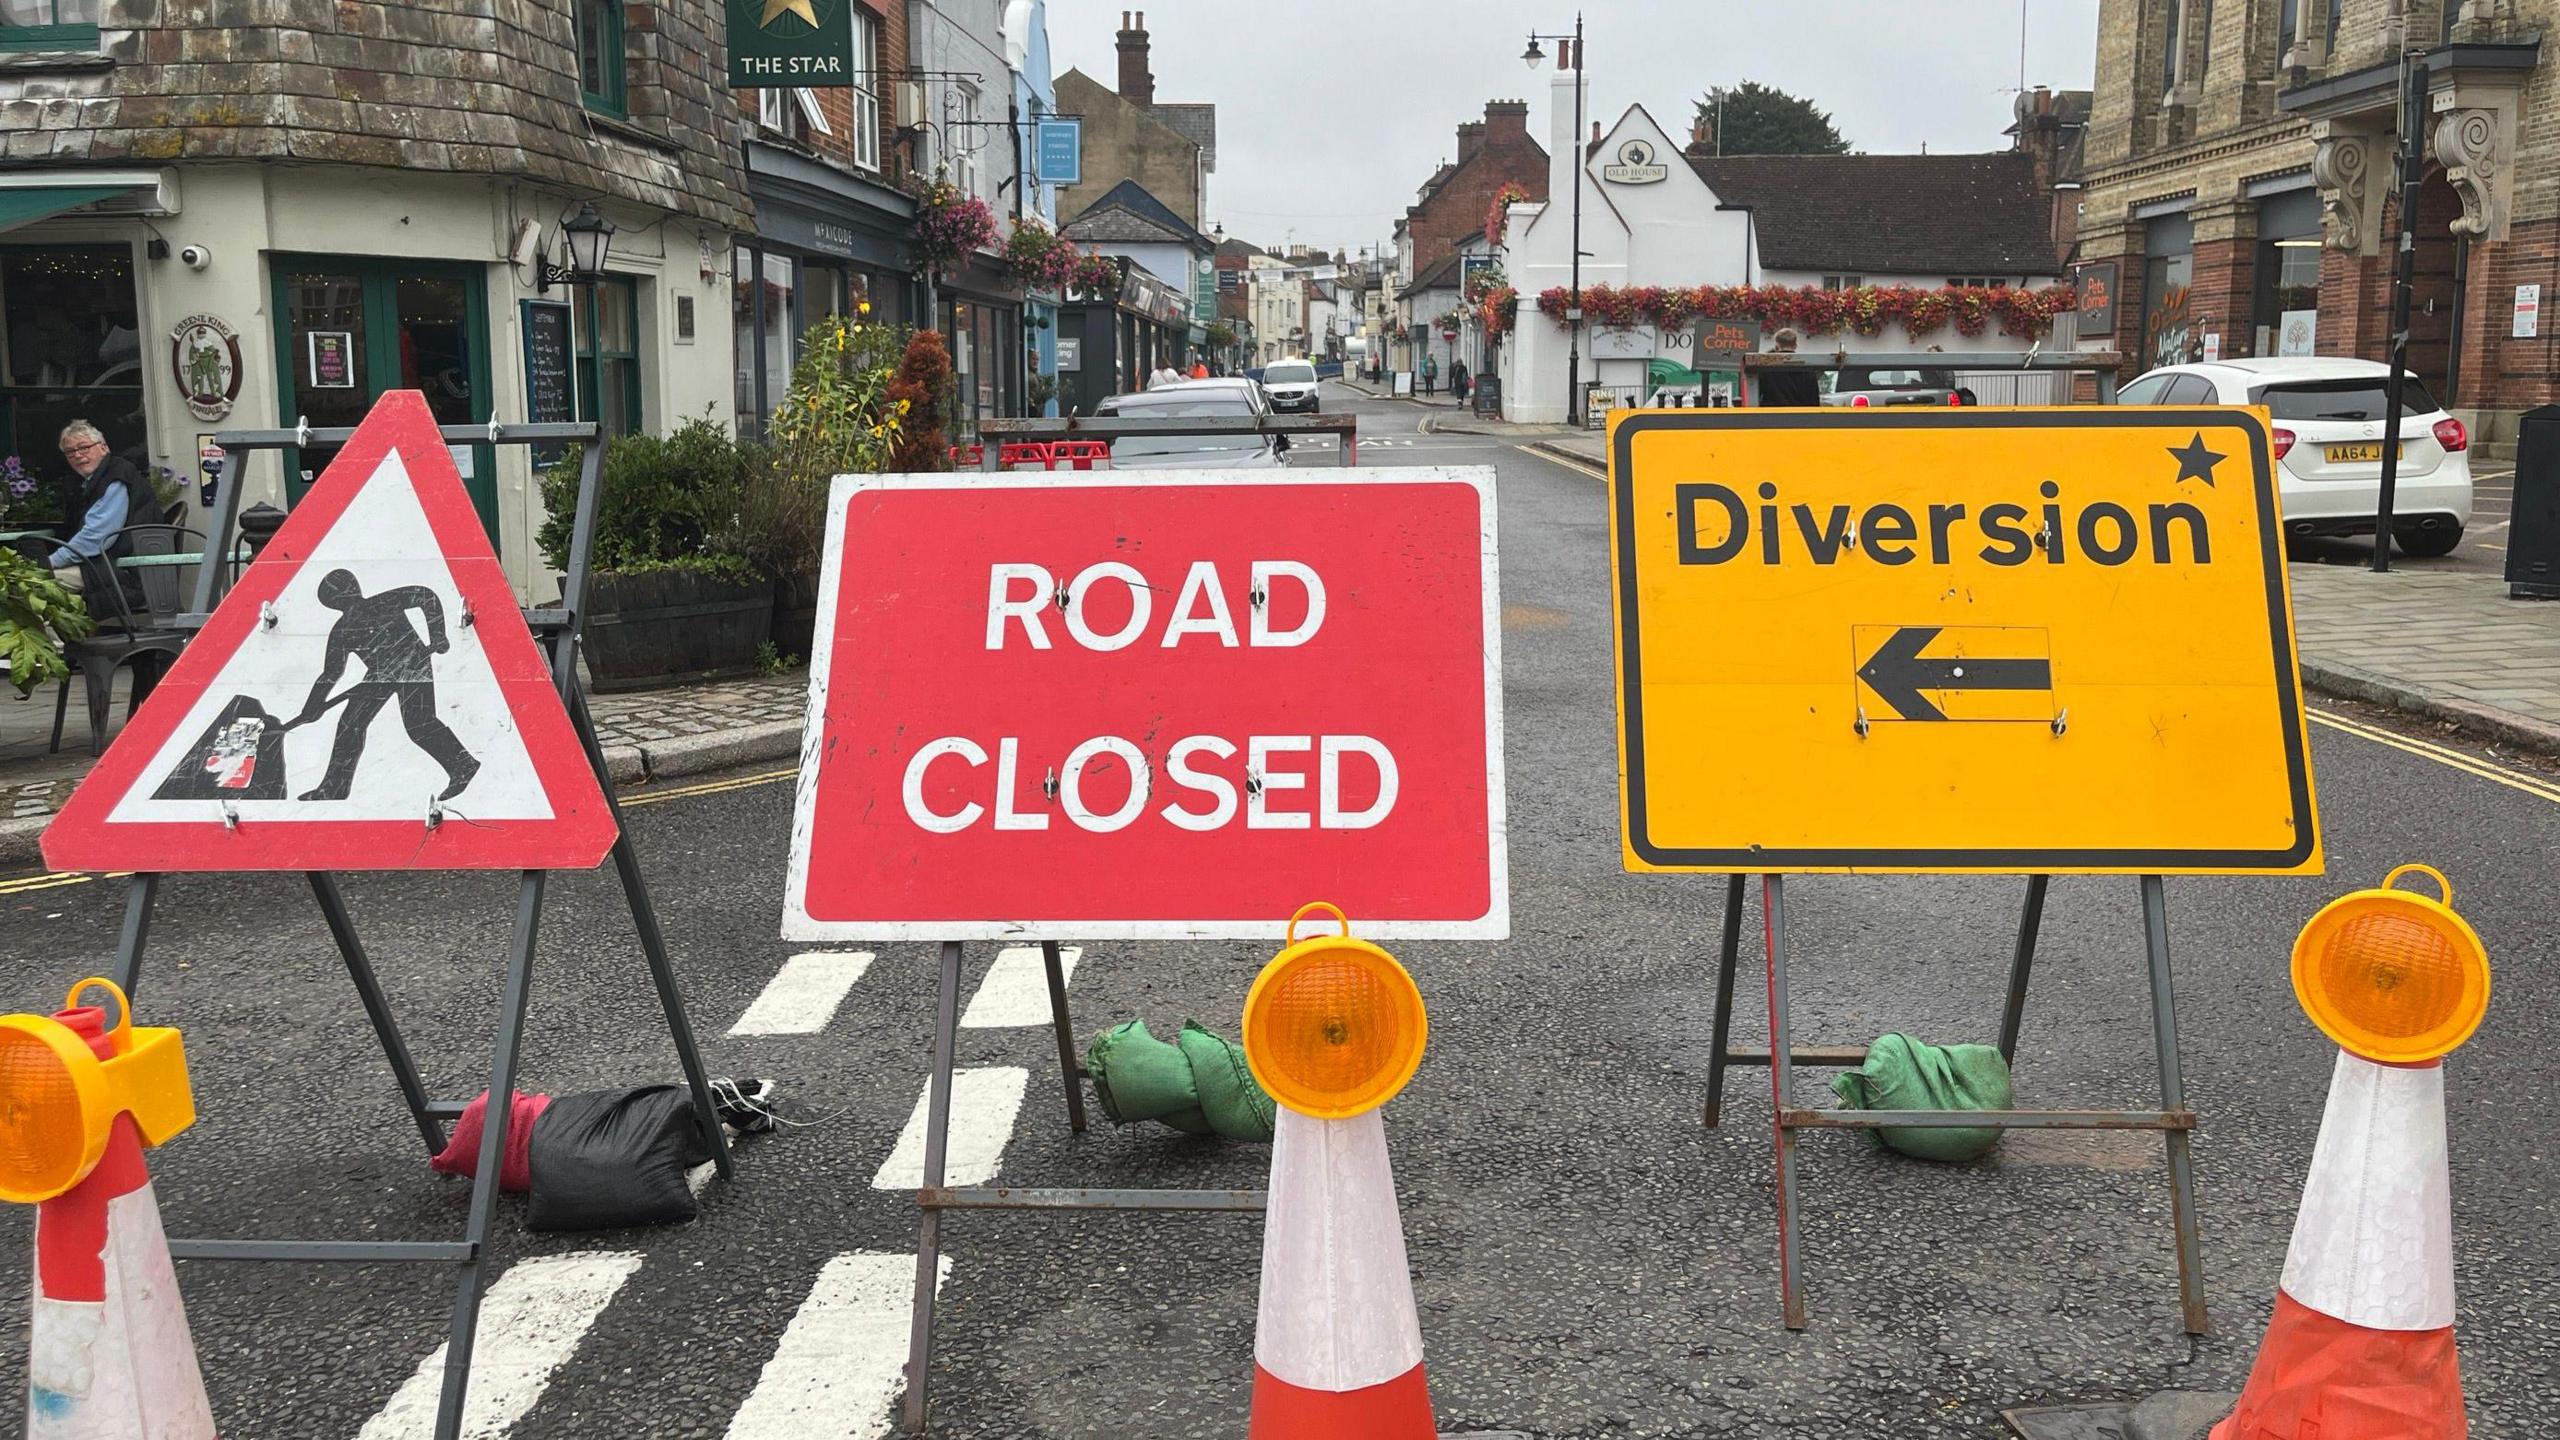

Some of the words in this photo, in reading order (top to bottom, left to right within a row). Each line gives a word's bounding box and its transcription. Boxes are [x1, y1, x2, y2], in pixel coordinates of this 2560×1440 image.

[740, 57, 783, 74] THE
[789, 56, 842, 73] STAR
[1608, 168, 1629, 177] OLD
[1630, 168, 1664, 177] HOUSE
[2087, 276, 2105, 295] Pets
[2081, 293, 2110, 311] Corner
[174, 314, 206, 336] GREENE
[208, 315, 231, 336] KING
[1715, 323, 1745, 339] Pets
[1703, 335, 1753, 350] Corner
[2331, 446, 2368, 460] AA64
[1674, 480, 2211, 567] Diversion
[985, 560, 1326, 651] ROAD
[902, 735, 1400, 834] CLOSED
